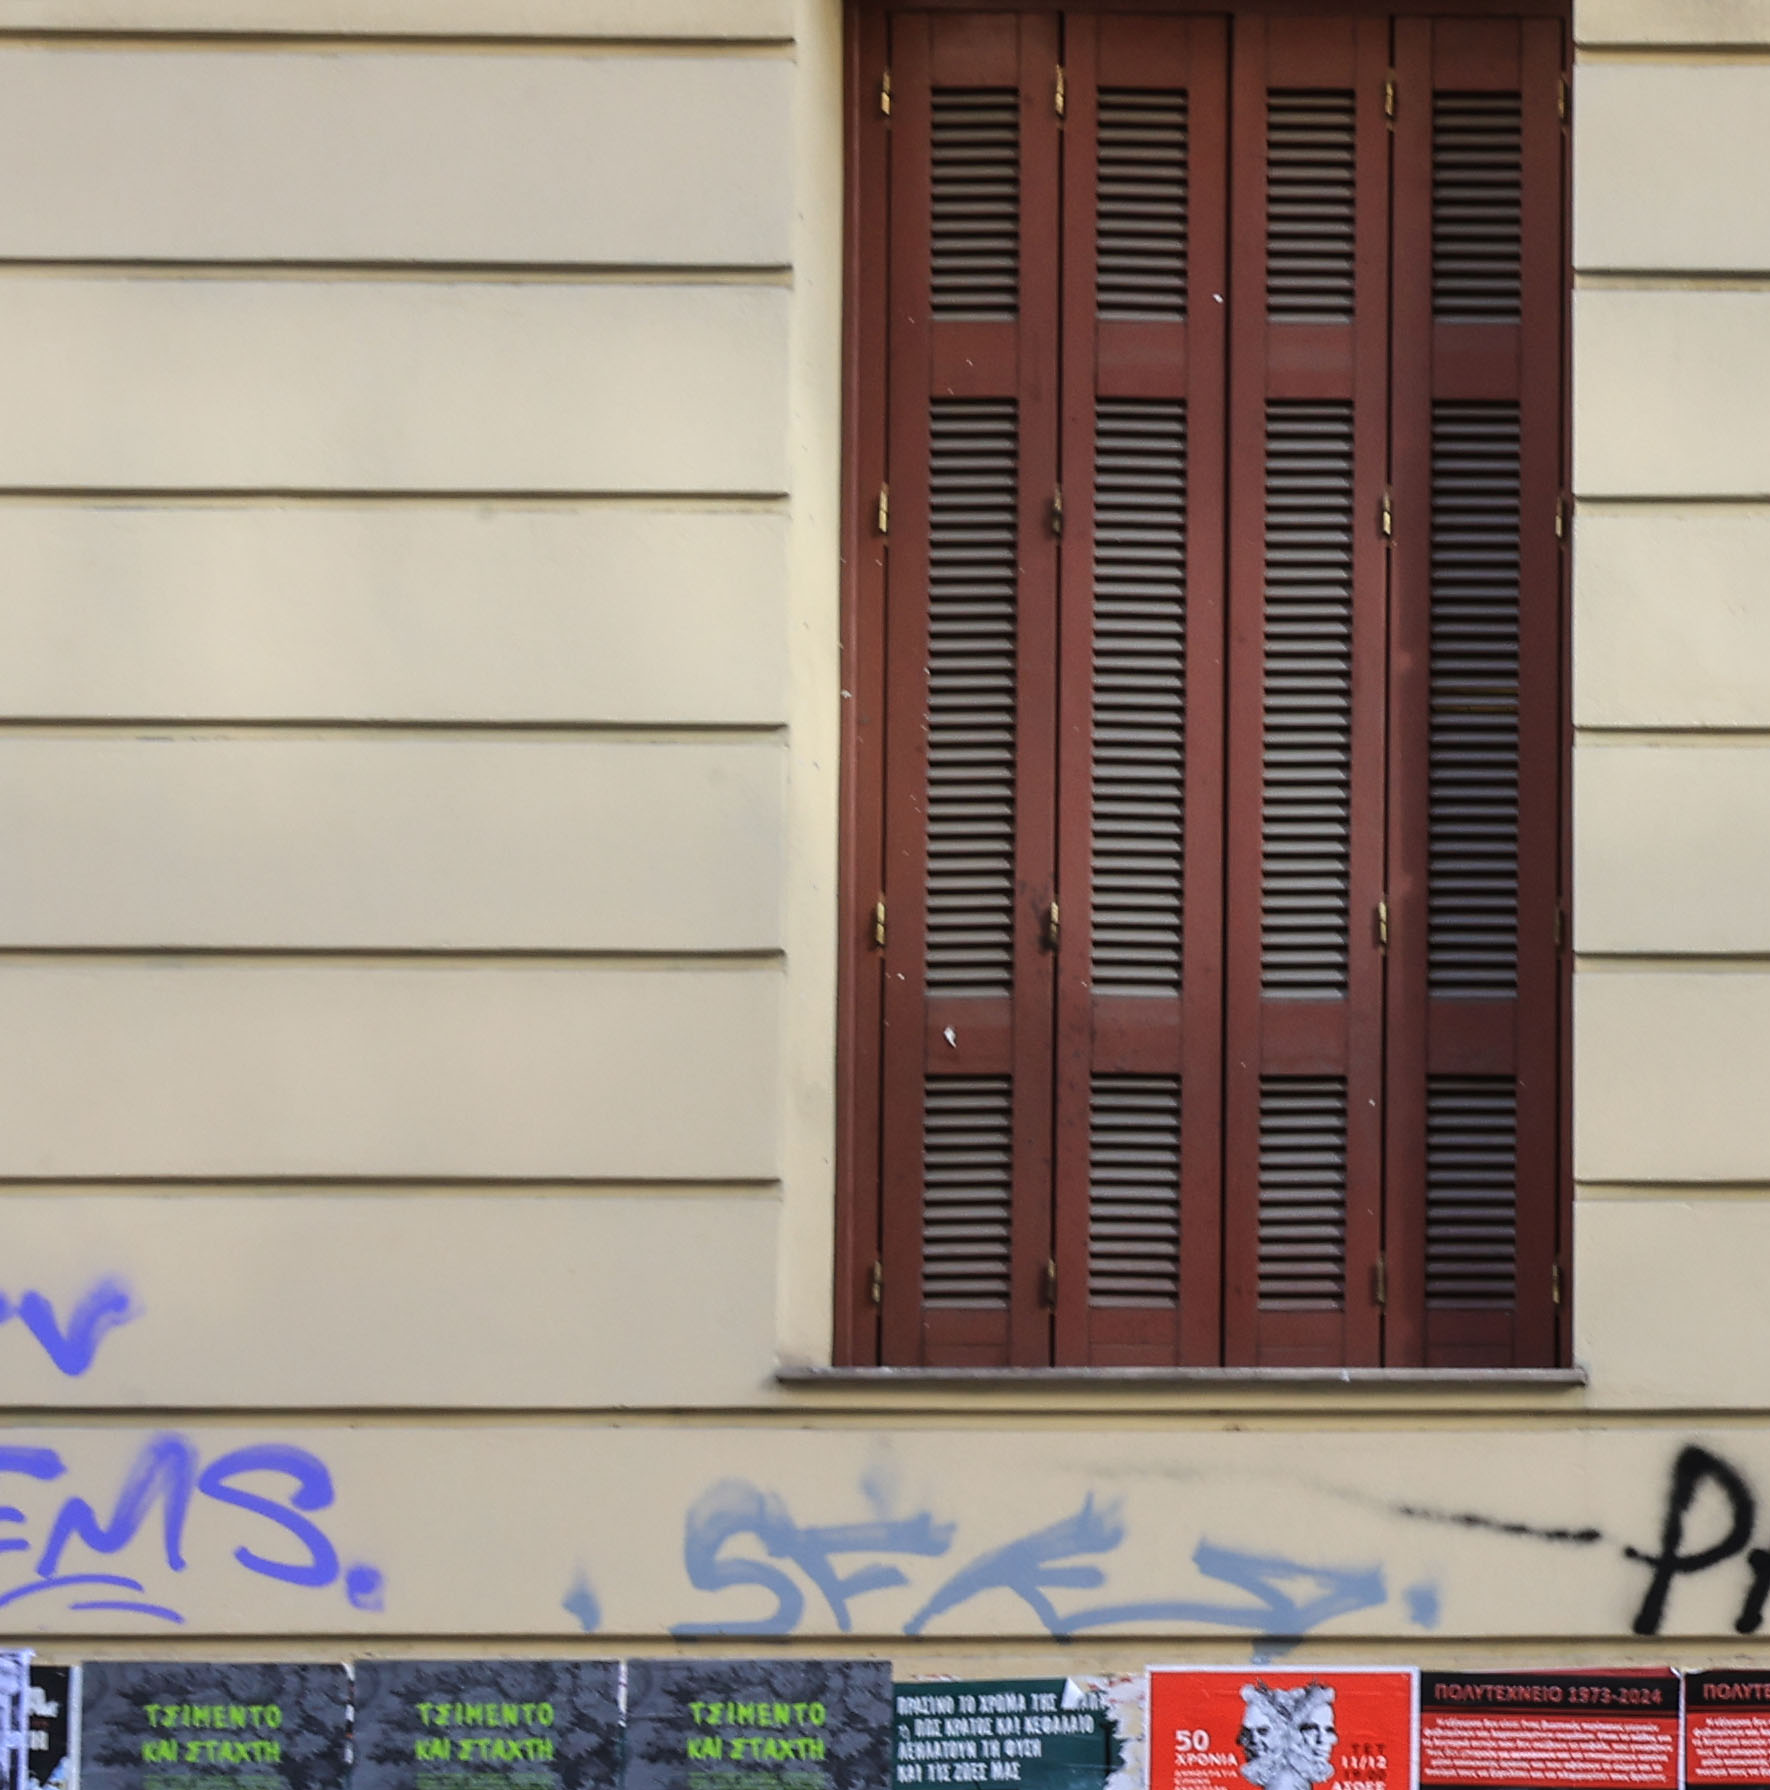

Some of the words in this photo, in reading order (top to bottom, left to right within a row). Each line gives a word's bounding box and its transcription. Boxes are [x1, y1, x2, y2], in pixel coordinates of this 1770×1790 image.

[958, 1694, 976, 1714] ΤΟ
[978, 1693, 1026, 1714] ΧΡΩΜΑ
[1030, 1692, 1057, 1712] ΤΗΣ
[1437, 1685, 1562, 1701] ΠΟΛΥΤΕΧΝΕΙΟ
[1568, 1686, 1663, 1704] 1973-2024
[143, 1703, 283, 1729] ΤΣΙΜΕΝΤΟ
[416, 1702, 554, 1727] ΤΣΙΜΕΝΤΟ
[689, 1700, 826, 1726] ΤΣΙΜΕΝΤΟ
[944, 1716, 994, 1737] ΚΡΑΤΟΣ
[995, 1715, 1020, 1736] ΚΑΙ
[1023, 1714, 1094, 1735] ΚΕΦΑΛΑΙΟ
[142, 1740, 178, 1763] ΚΑΙ
[185, 1739, 281, 1764] ΣΤΑΧΤΗ
[414, 1739, 451, 1761] ΚΑΙ
[457, 1737, 553, 1762] ΣΤΑΧΤΗ
[687, 1738, 725, 1760] ΚΑΙ
[730, 1736, 825, 1761] ΣΤΑΧΤΗ
[980, 1738, 1000, 1758] ΤΗ
[1003, 1738, 1042, 1758] ΦΥΣΗ
[1175, 1729, 1210, 1752] 50
[1174, 1752, 1239, 1767] ΧΡΟΝΙΑ
[1341, 1755, 1388, 1770] 11/12
[896, 1763, 923, 1783] ΚΑΙ
[926, 1762, 951, 1782] ΤΙΣ
[990, 1760, 1021, 1781] ΜΑΣ
